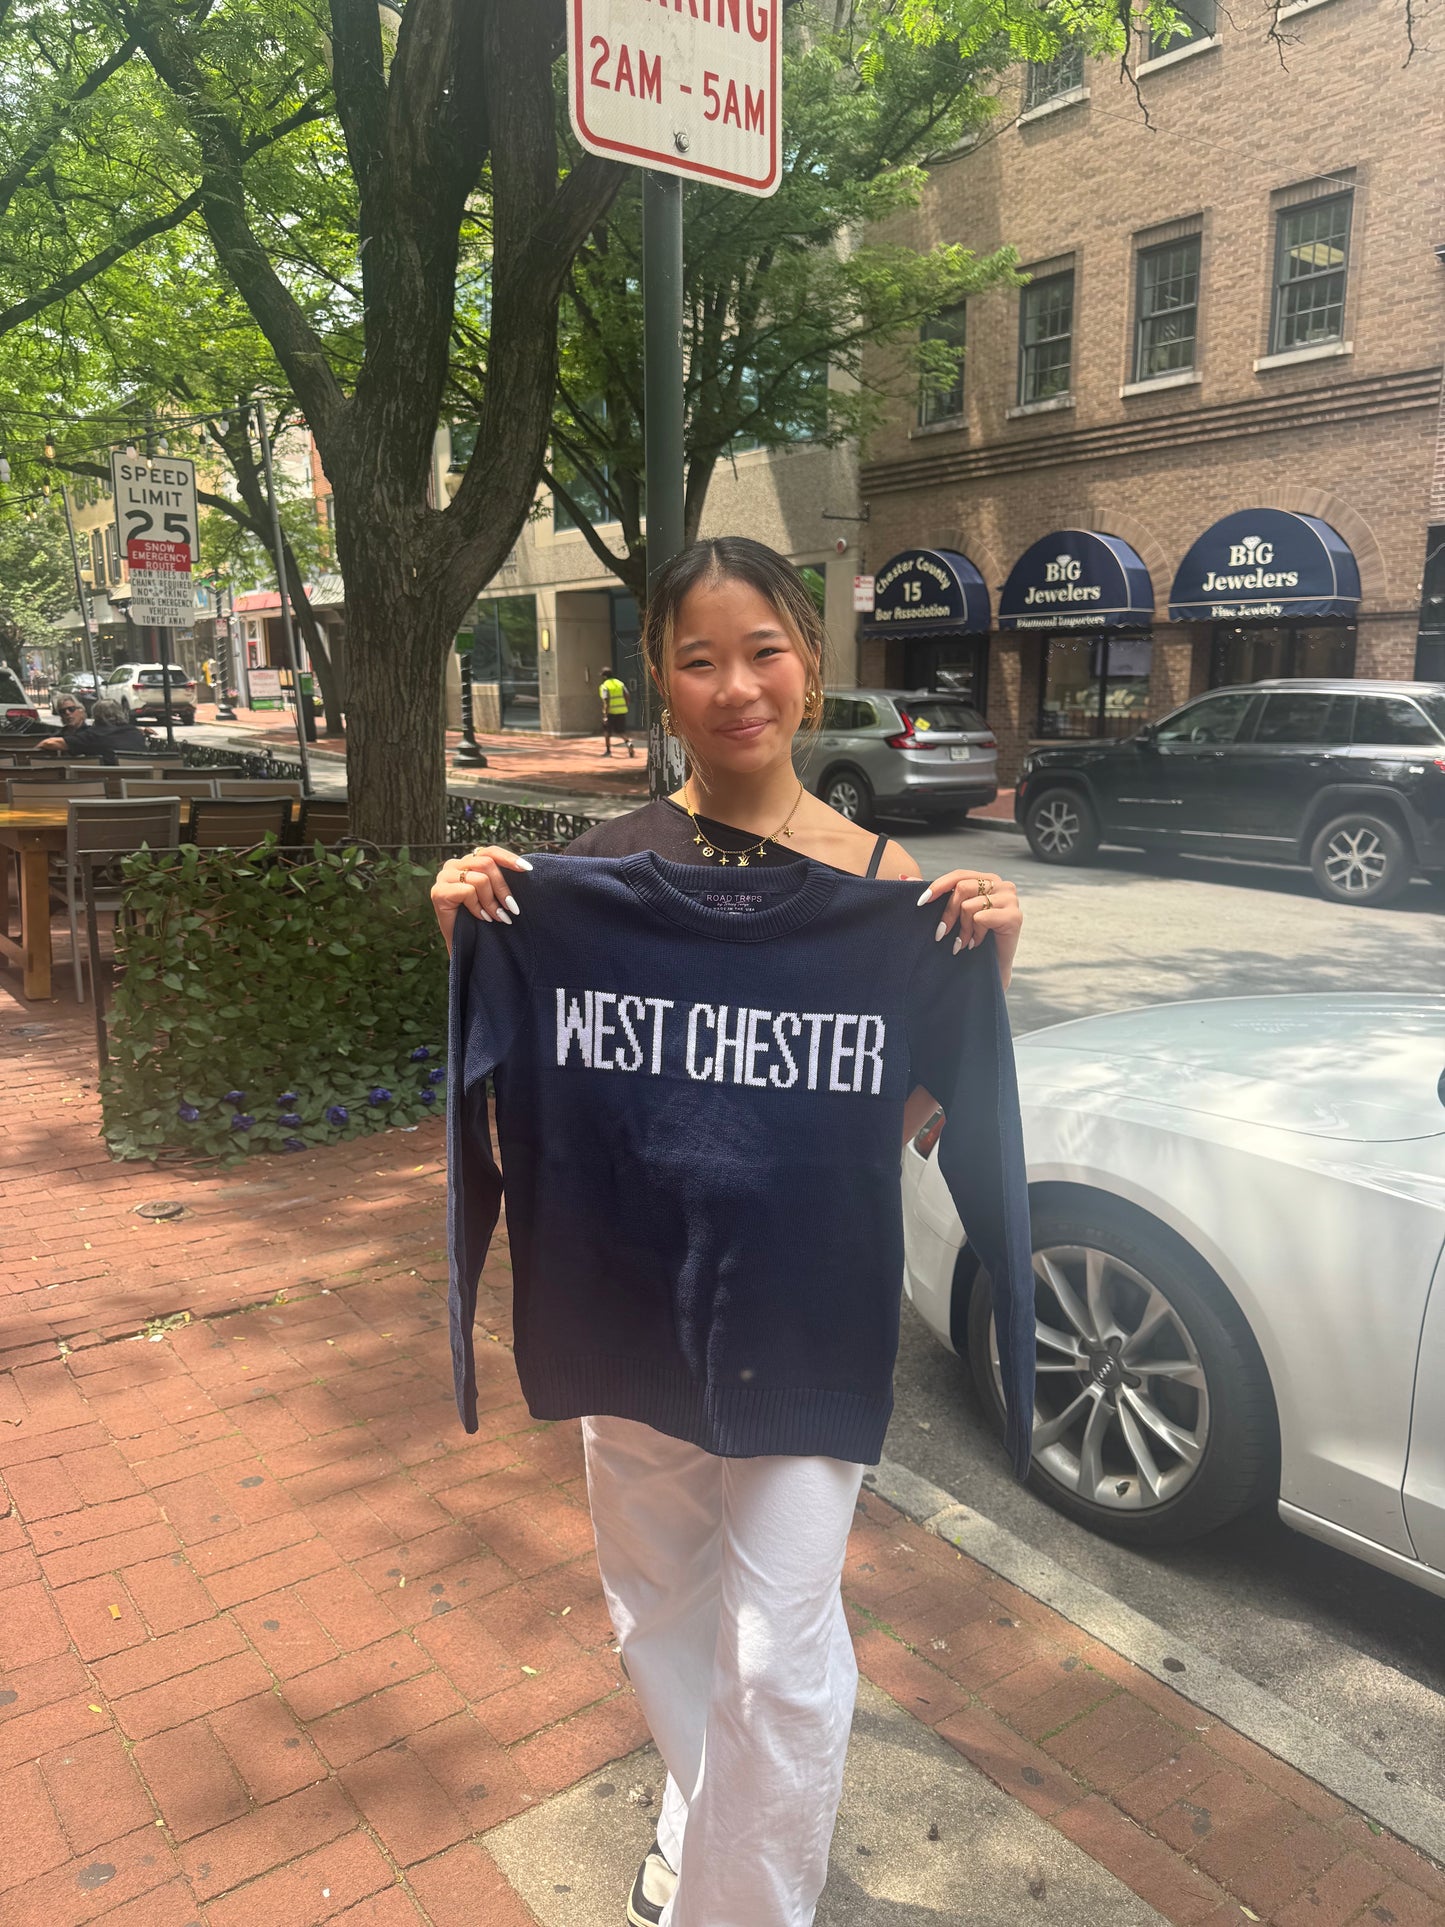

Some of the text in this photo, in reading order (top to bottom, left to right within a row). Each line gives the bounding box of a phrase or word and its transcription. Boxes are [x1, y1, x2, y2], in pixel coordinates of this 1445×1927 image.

[590, 35, 662, 104] 2AM
[703, 70, 765, 136] 5AM
[120, 465, 189, 486] SPEED
[129, 487, 183, 507] LIMIT
[124, 509, 191, 545] 25
[144, 542, 175, 553] SNOW
[132, 550, 188, 563] EMERGENCY
[145, 561, 176, 571] ROUTE
[132, 569, 153, 578] SNOW
[157, 570, 177, 580] TIRES
[876, 556, 952, 594] Chester County
[1202, 567, 1299, 592] Jewelers
[132, 578, 192, 590] CHAINS REQUIRED
[903, 581, 923, 602] 15
[137, 588, 149, 597] NO
[1024, 582, 1101, 605] Jewelers
[131, 597, 156, 606] DURING
[158, 598, 193, 608] EMERGENCY
[1237, 602, 1284, 617] Jewelry
[149, 607, 179, 617] VEHICLES
[875, 603, 951, 621] Bar Association
[142, 615, 186, 625] TOWED AWAY
[706, 894, 733, 902] ROAD
[556, 988, 886, 1095] WEST CHESTER
